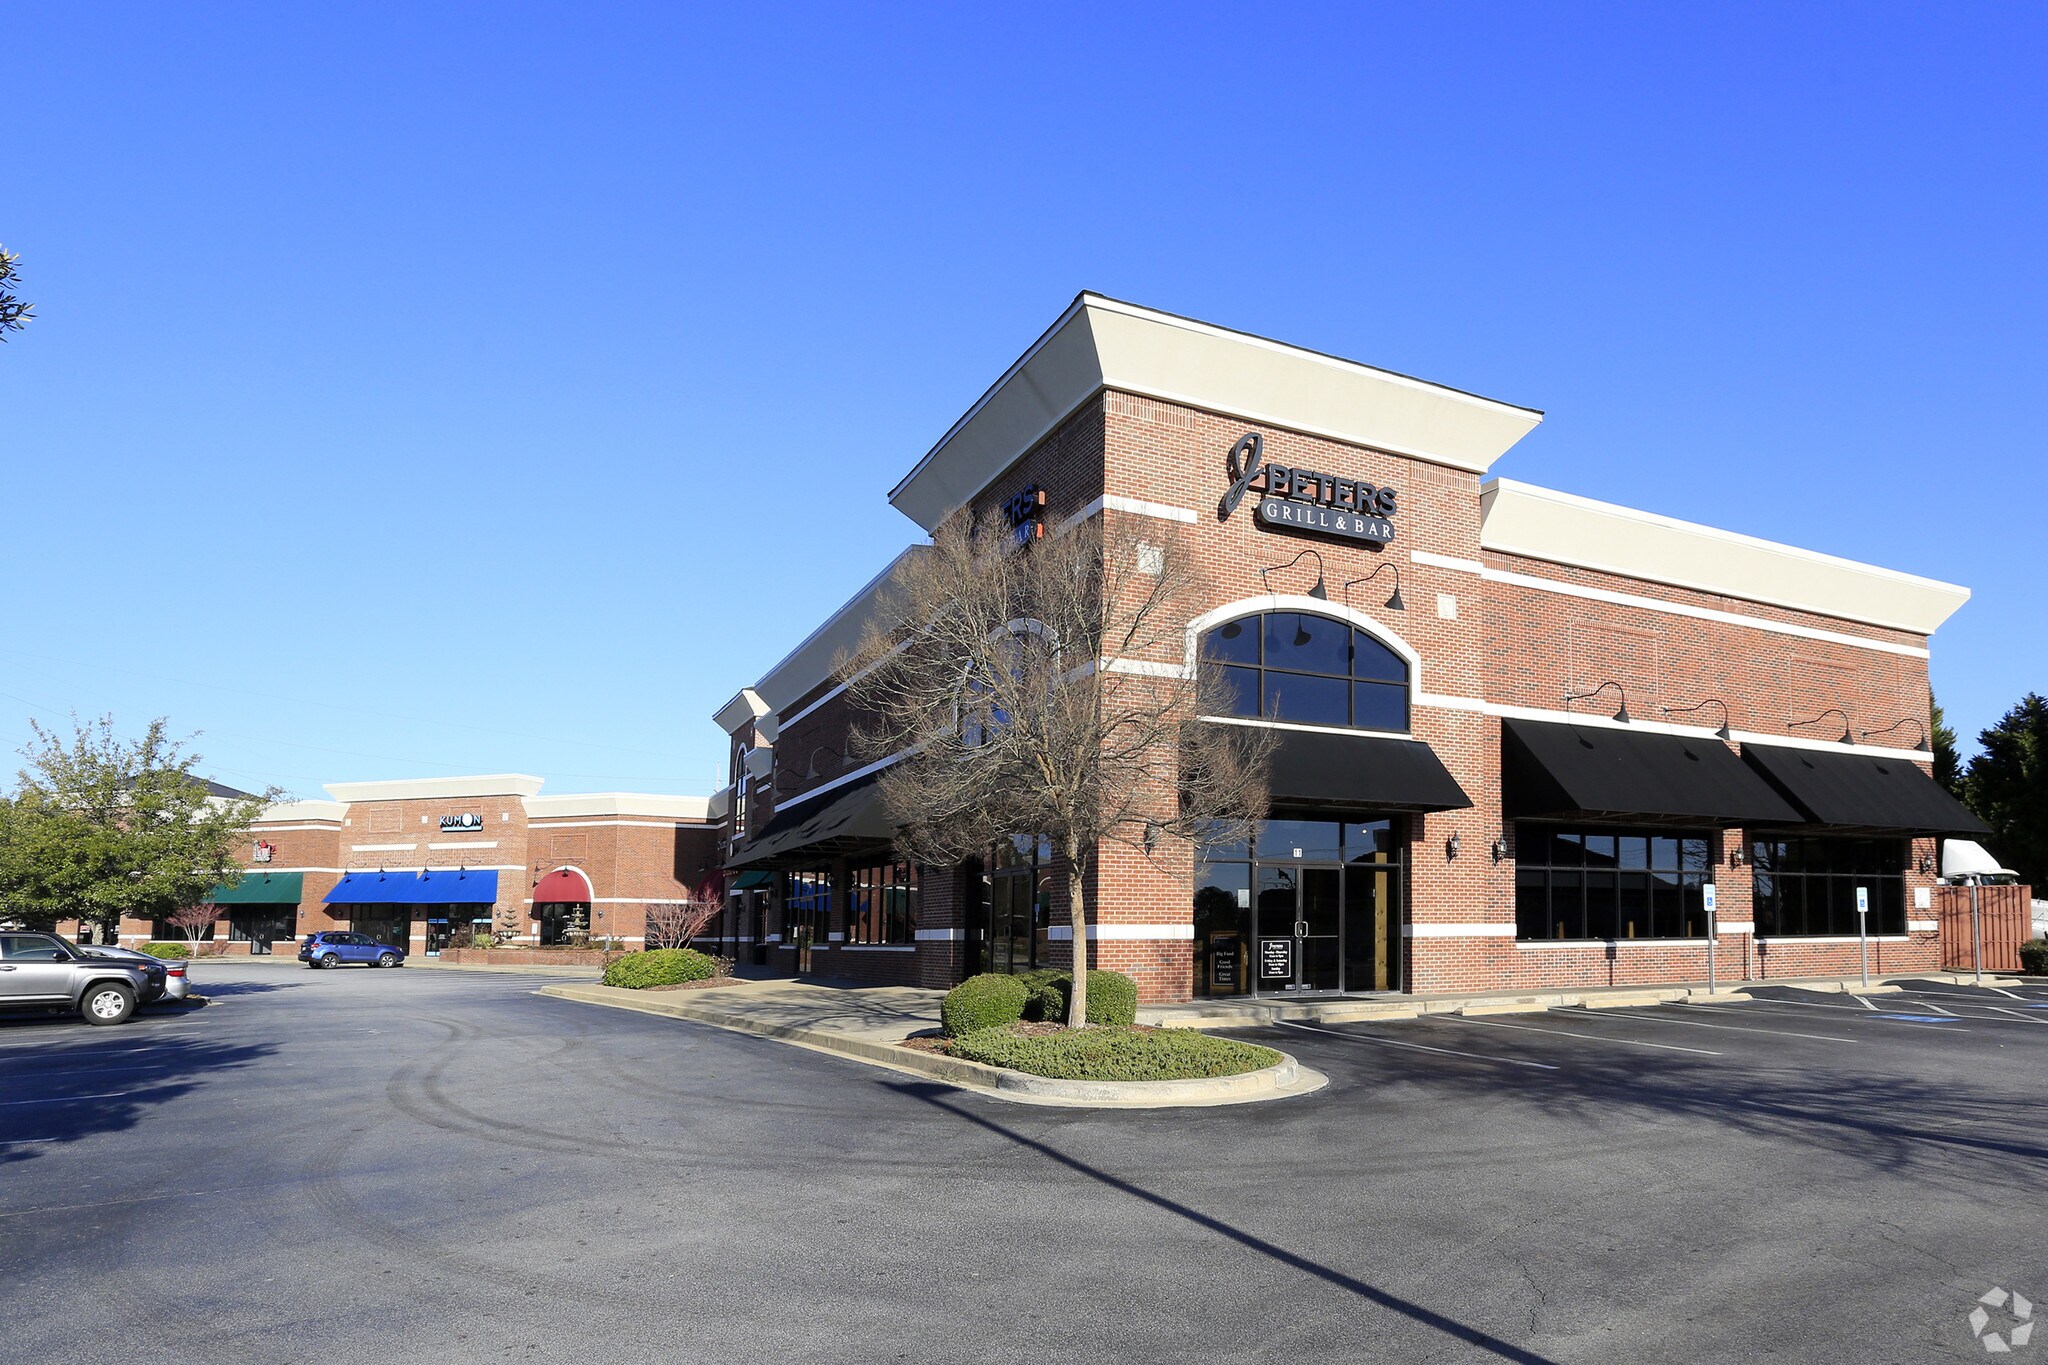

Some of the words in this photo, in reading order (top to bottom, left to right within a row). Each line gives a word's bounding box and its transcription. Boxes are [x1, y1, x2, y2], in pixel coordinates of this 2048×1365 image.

[1265, 463, 1397, 516] PETERS
[1266, 502, 1329, 527] GRILL
[1335, 515, 1347, 531] &
[1354, 519, 1392, 539] BAR
[439, 812, 482, 827] KUMON
